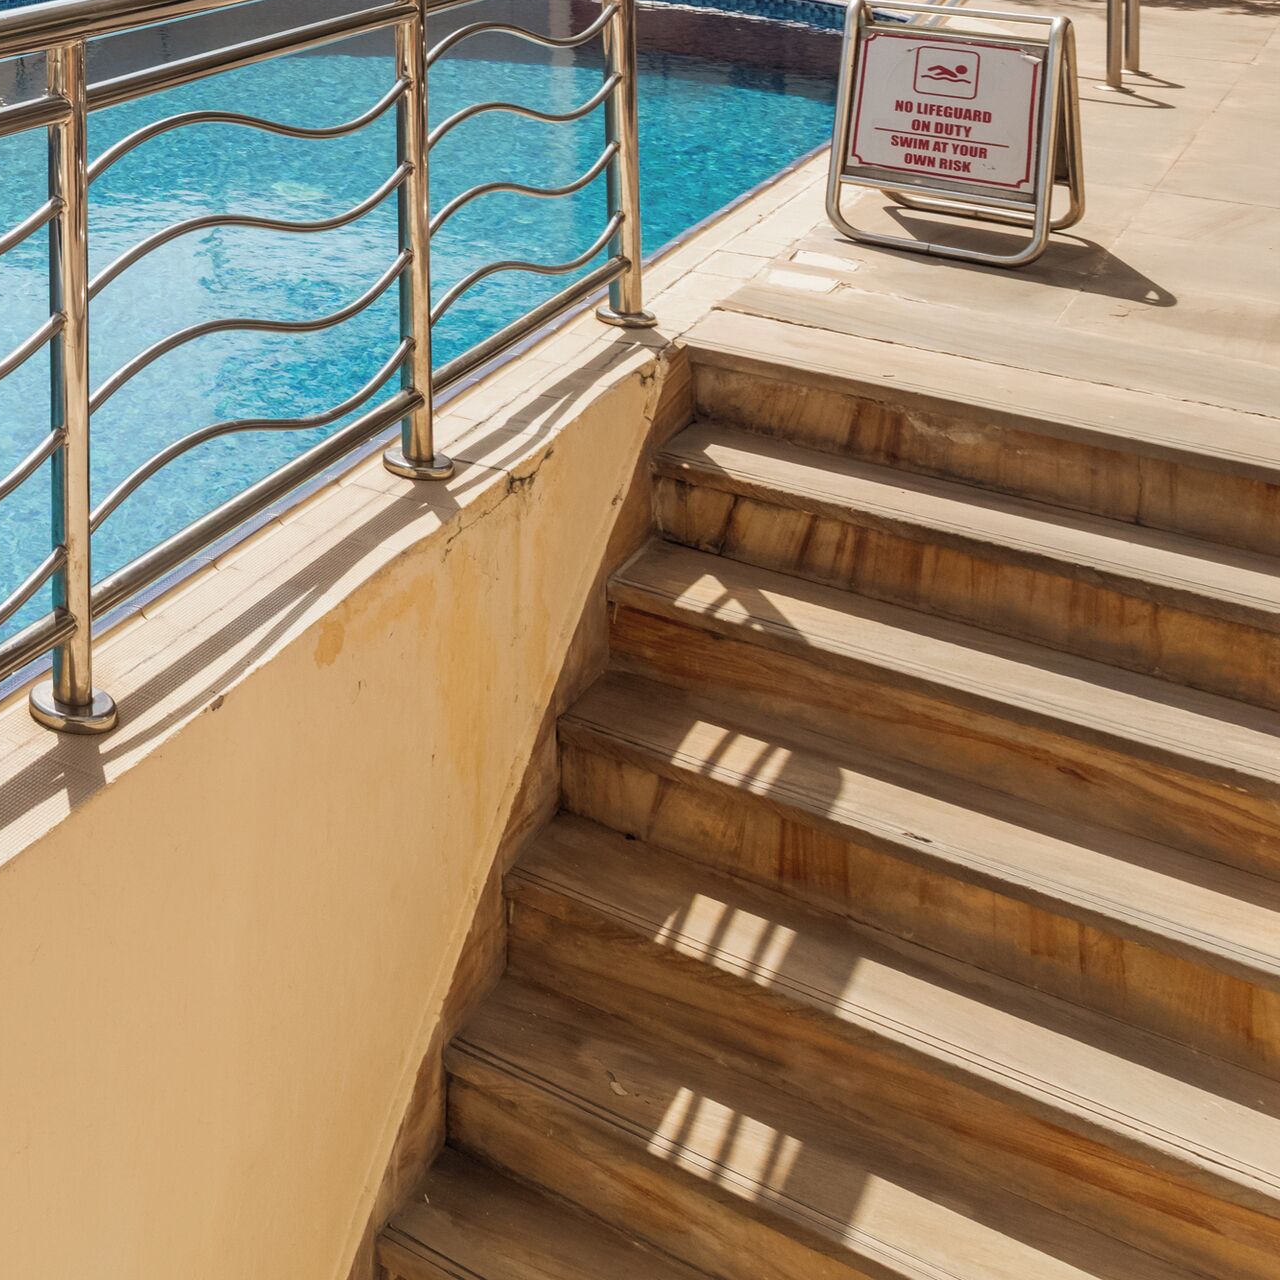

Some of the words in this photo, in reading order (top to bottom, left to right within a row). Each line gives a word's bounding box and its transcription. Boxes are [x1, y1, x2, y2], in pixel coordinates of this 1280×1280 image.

[895, 100, 914, 113] NO
[916, 102, 992, 123] LIFEGUARD
[911, 119, 931, 132] ON
[934, 122, 972, 138] DUTY
[890, 135, 930, 151] SWIM
[932, 141, 949, 153] AT
[951, 143, 988, 159] YOUR
[904, 153, 936, 168] OWN
[939, 158, 972, 173] RISK
